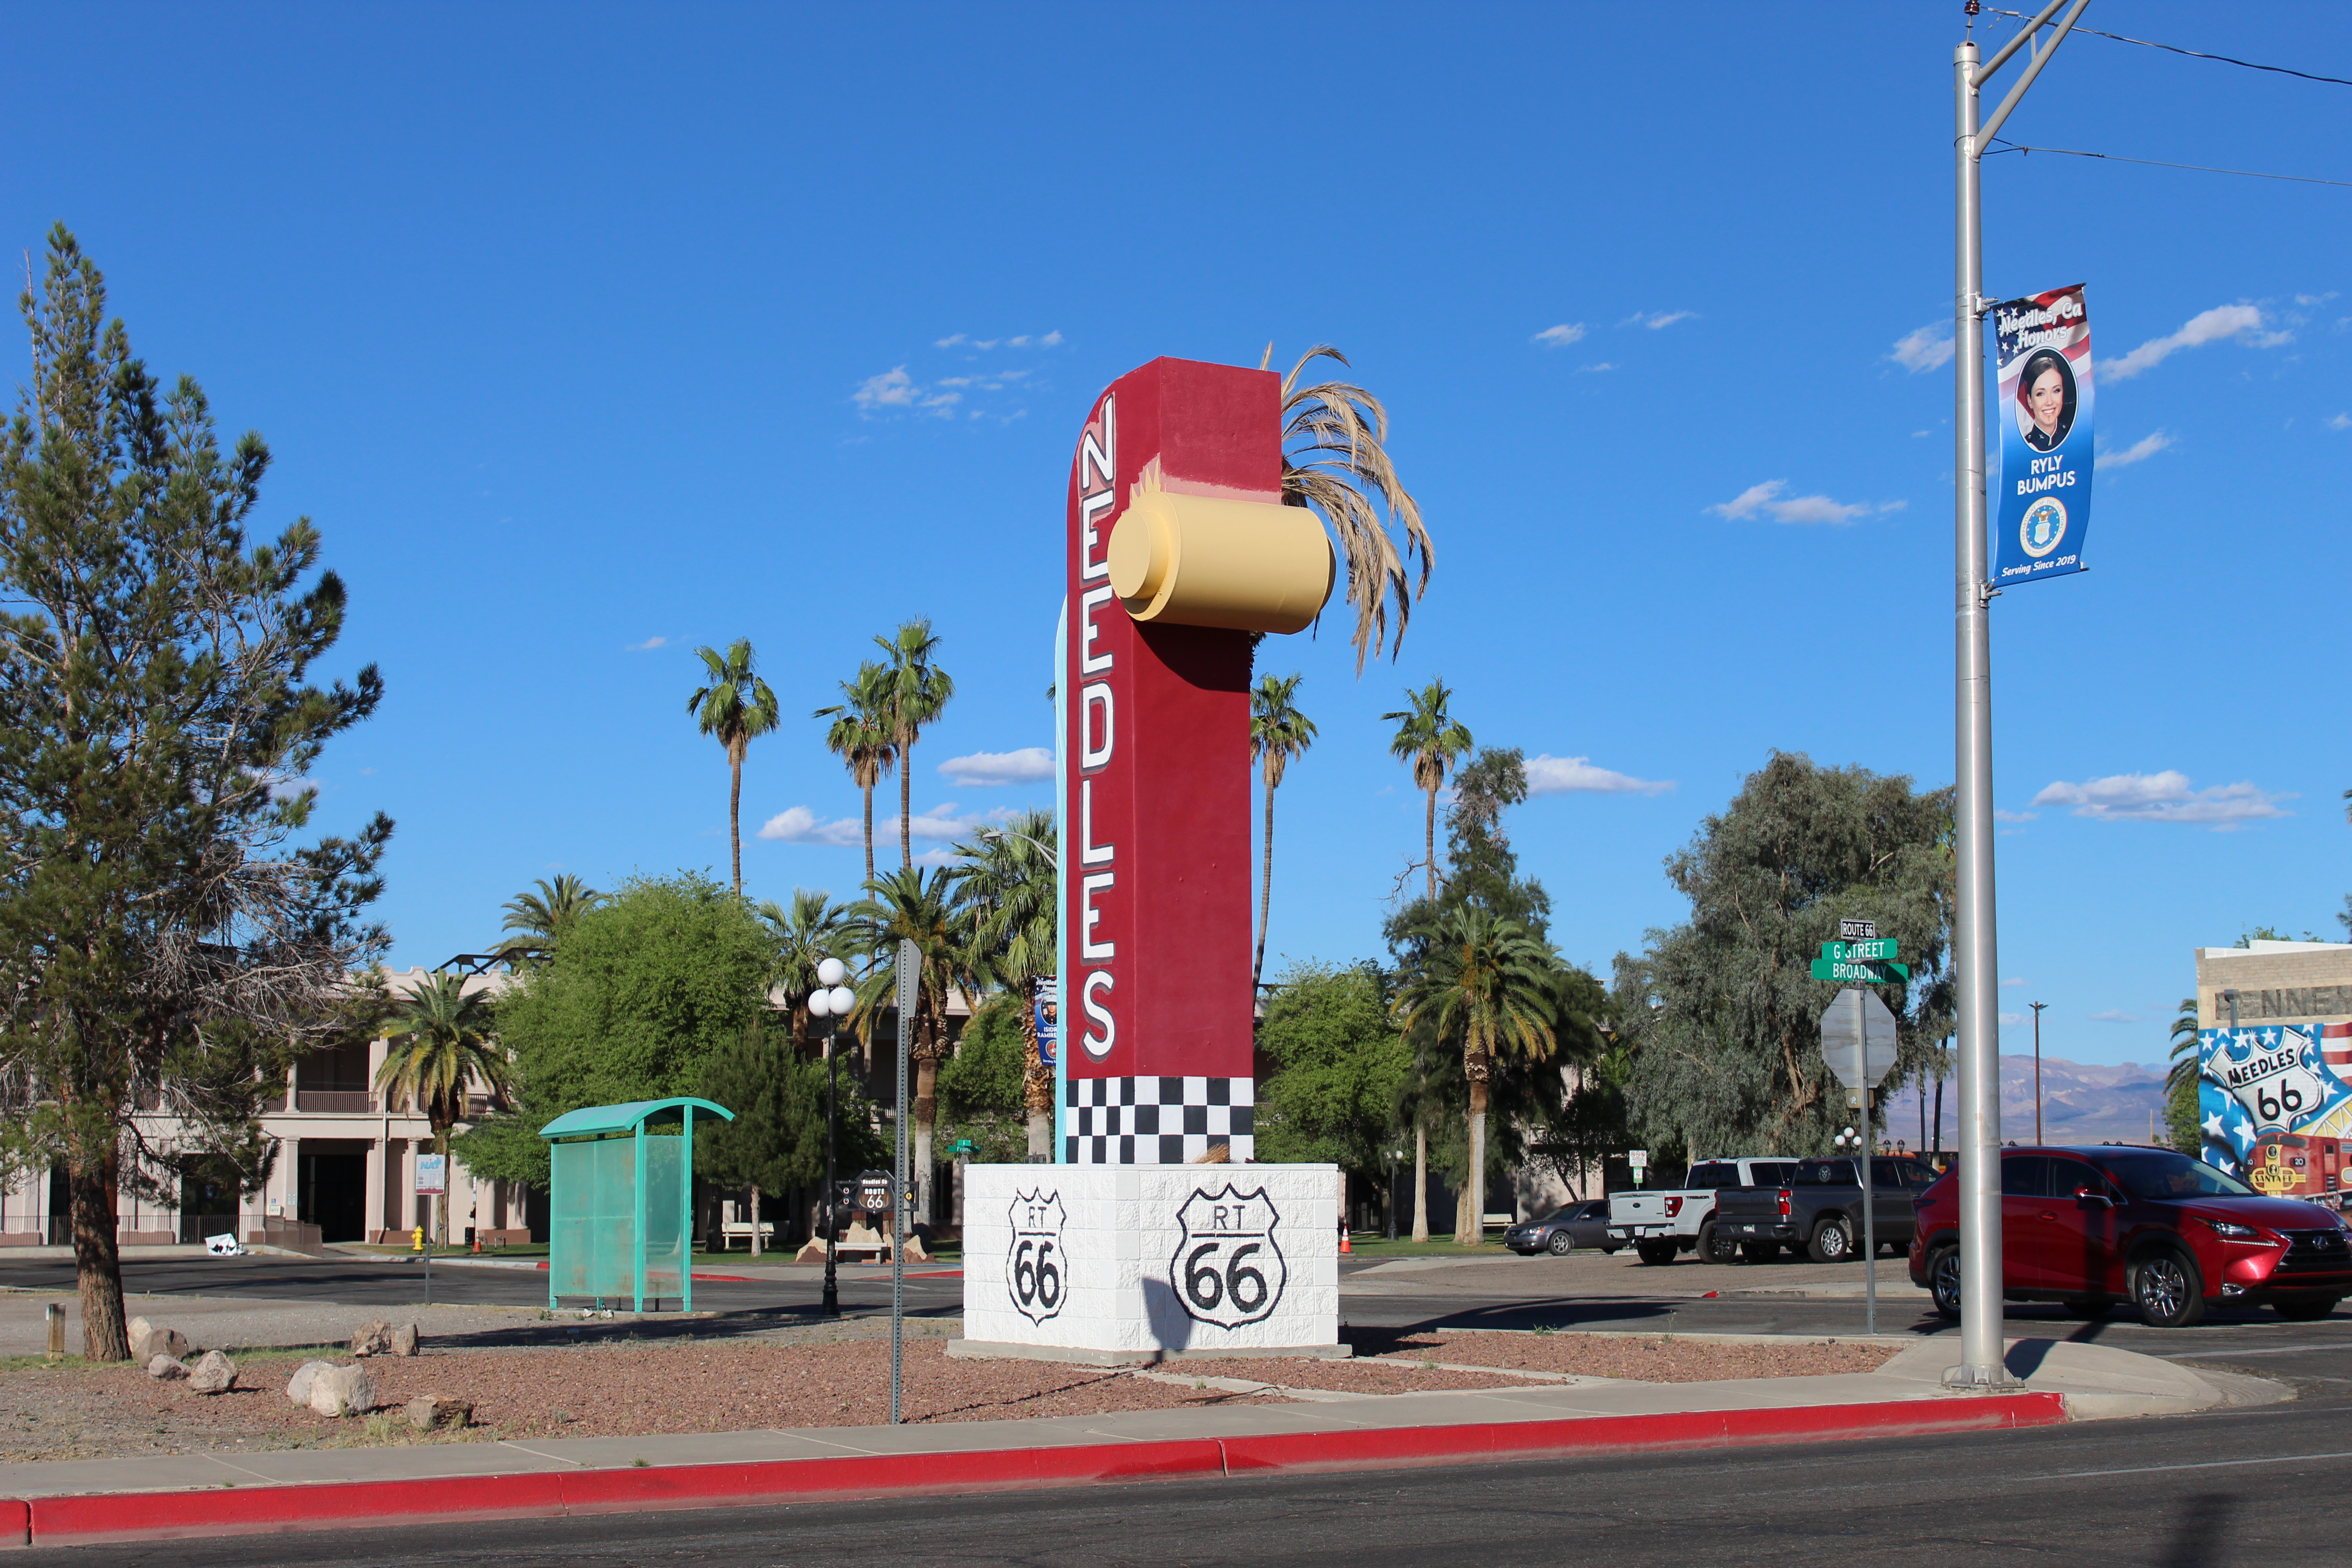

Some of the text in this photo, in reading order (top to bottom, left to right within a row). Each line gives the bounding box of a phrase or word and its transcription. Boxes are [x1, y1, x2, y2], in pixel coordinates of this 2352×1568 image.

[1999, 301, 2082, 337] Needles, Ca
[2017, 326, 2067, 349] Honors
[2031, 454, 2063, 475] RYLY
[2017, 470, 2076, 495] BUMPUS
[2001, 554, 2076, 577] Serving Since 2019
[1081, 394, 1116, 1058] NEEDLES
[1843, 923, 1873, 937] ROUTE 66
[1833, 942, 1884, 959] G STREET
[1833, 963, 1886, 980] BROADWAY
[2228, 1049, 2294, 1086] NEEDLES
[2258, 1079, 2302, 1121] 66
[867, 1195, 883, 1208] 66
[1029, 1206, 1047, 1228] RT
[1214, 1205, 1245, 1230] RT
[1014, 1240, 1059, 1309] 66
[1186, 1243, 1267, 1313] 66
